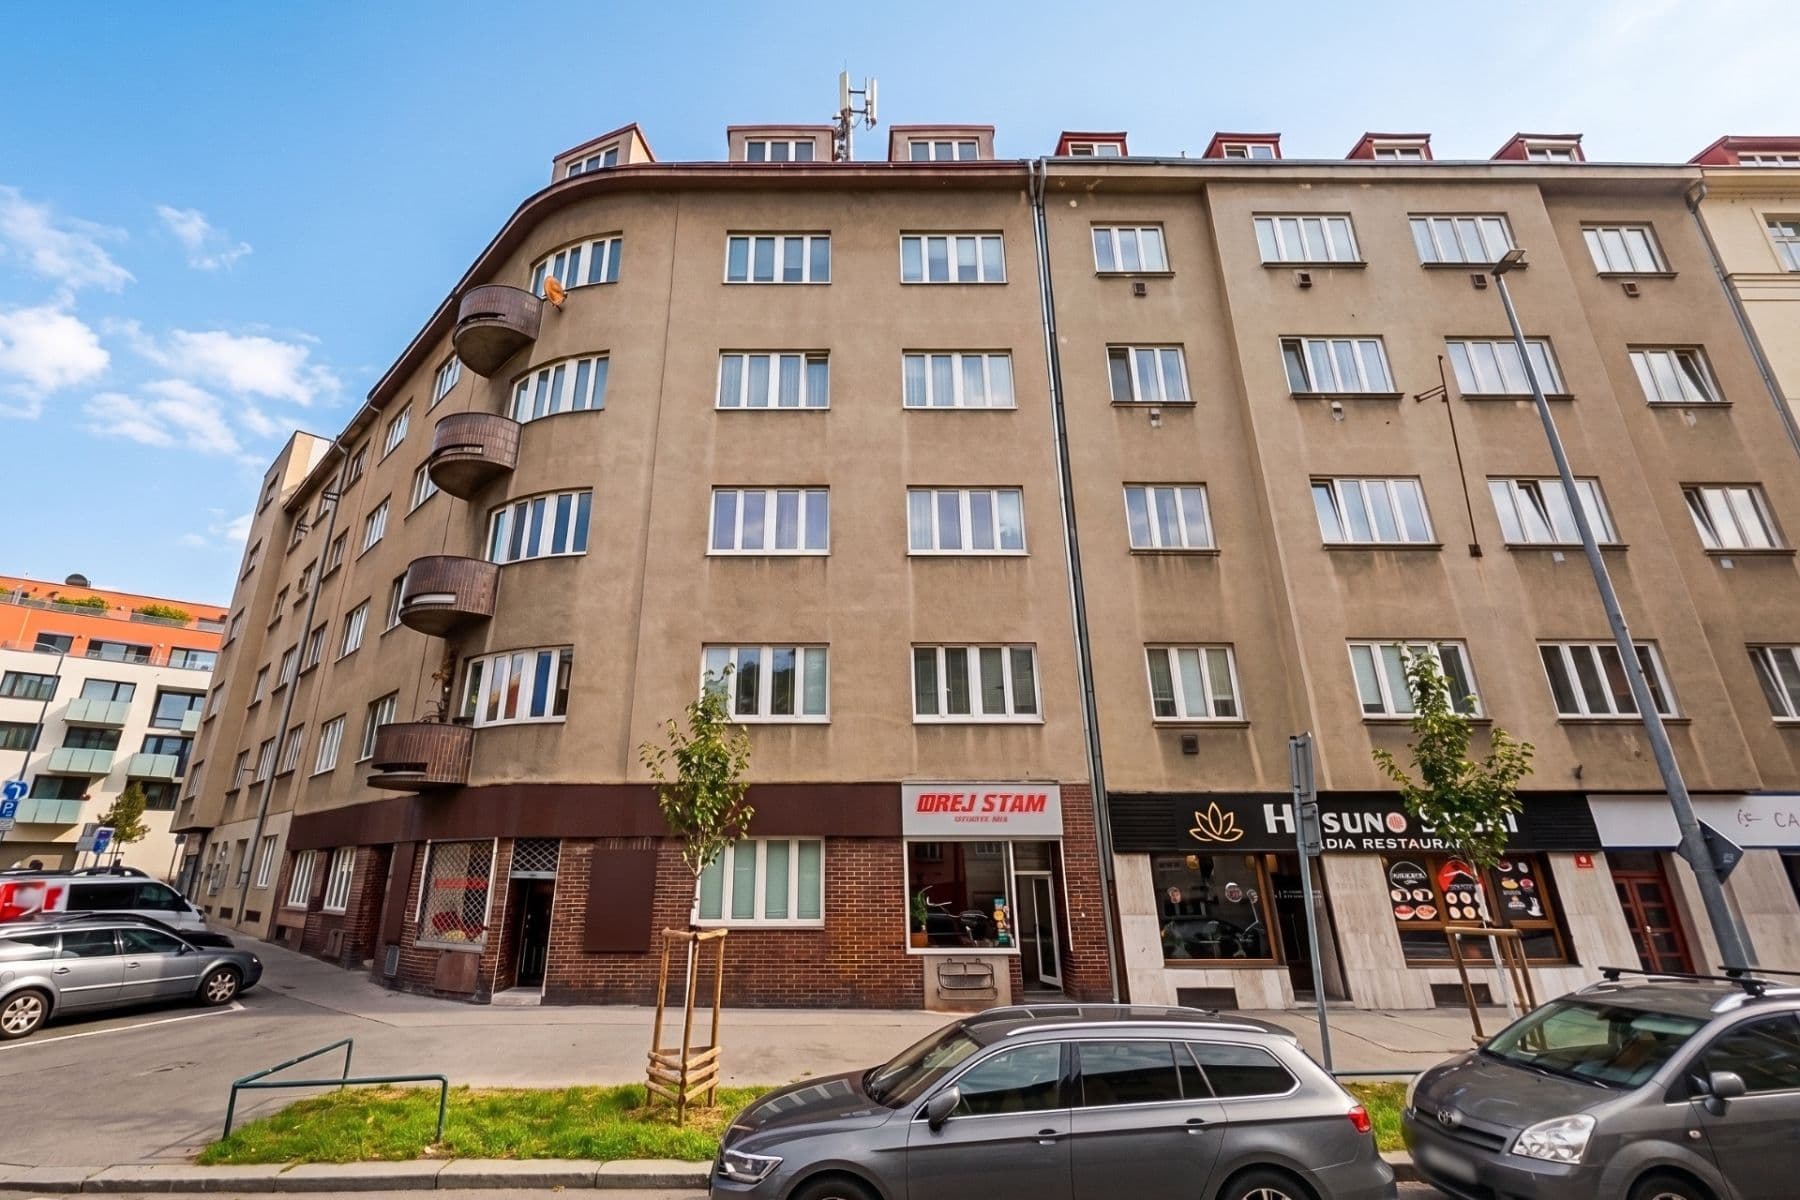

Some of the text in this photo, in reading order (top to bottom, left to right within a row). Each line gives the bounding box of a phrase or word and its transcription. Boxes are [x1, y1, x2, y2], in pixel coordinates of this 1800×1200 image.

[2, 802, 14, 814] P
[982, 794, 1047, 812] STAM
[1263, 803, 1407, 834] HSUNO
